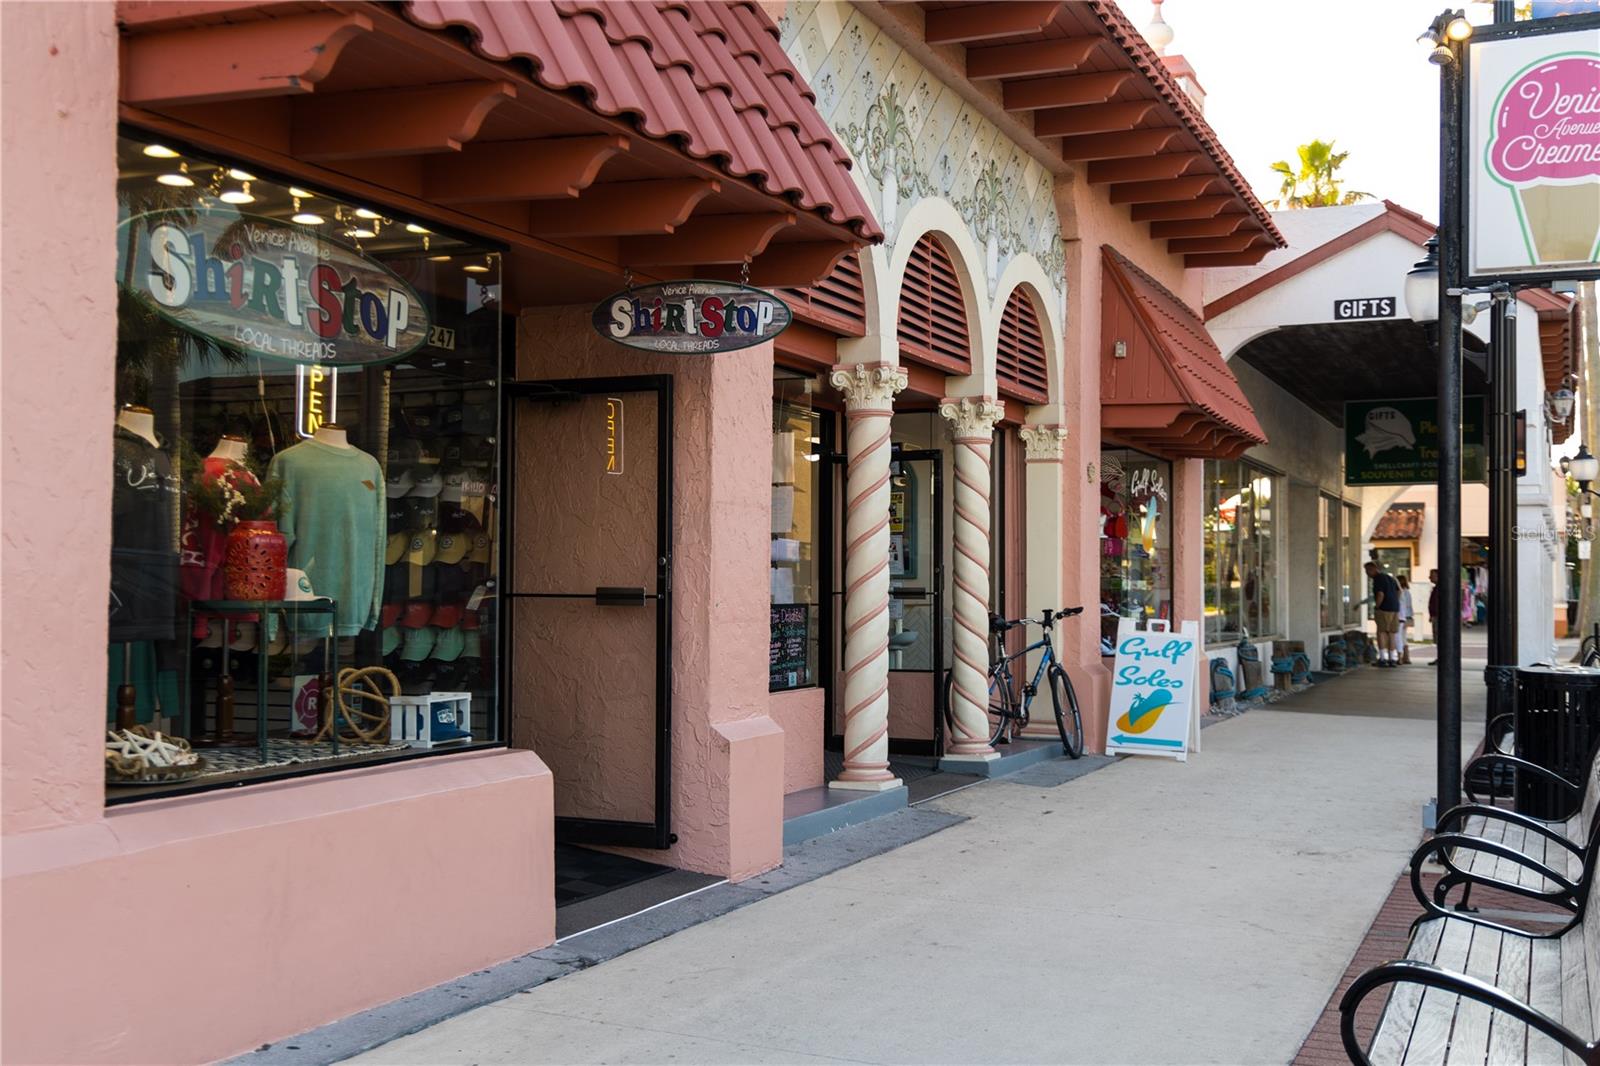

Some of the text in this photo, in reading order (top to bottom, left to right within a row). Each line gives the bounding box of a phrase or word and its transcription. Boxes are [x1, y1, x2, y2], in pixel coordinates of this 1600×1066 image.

[244, 224, 330, 261] Venice Avenue
[662, 284, 718, 297] Venice Avenue
[1339, 299, 1391, 317] GIFTS
[234, 326, 337, 359] LOCAL THREADS
[428, 326, 453, 347] 247
[655, 339, 720, 351] LOCAL THREADS
[308, 365, 323, 434] PEN
[1368, 410, 1396, 421] GIFTS
[1360, 470, 1415, 480] SOUVENIR
[1119, 637, 1193, 665] Gulf
[1115, 665, 1183, 688] Soles
